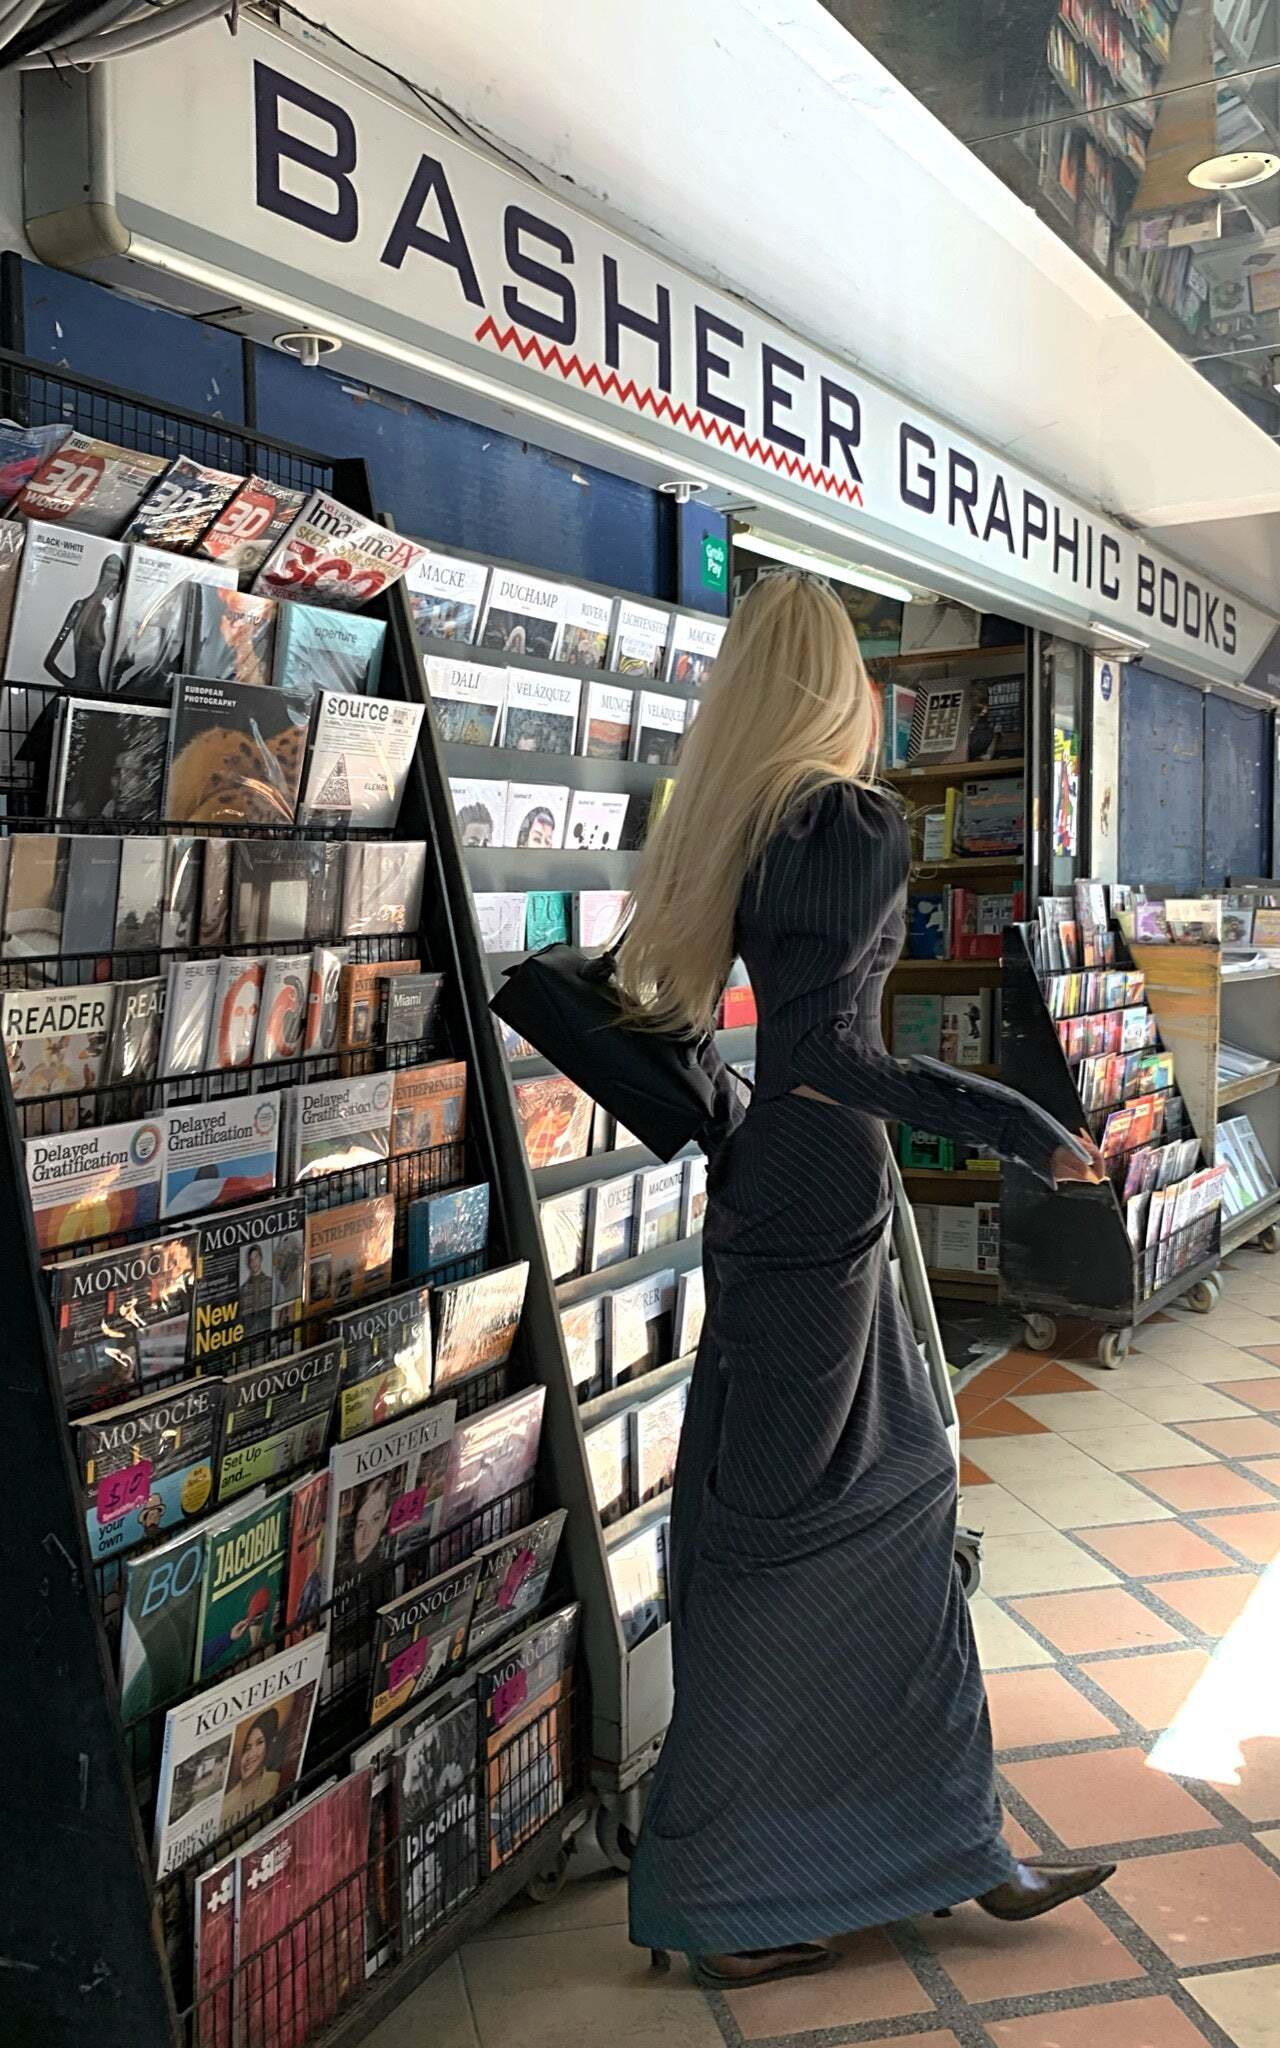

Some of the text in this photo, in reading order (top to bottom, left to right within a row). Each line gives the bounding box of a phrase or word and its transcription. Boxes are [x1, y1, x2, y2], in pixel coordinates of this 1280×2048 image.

[253, 59, 1236, 655] BASHEER GRAPHIC BOOKS
[27, 458, 96, 497] 3D
[24, 490, 75, 513] WORLD
[213, 500, 270, 538] 3D
[306, 499, 424, 569] ImaneFX
[706, 543, 724, 562] Grab
[418, 563, 466, 588] MACKE
[707, 557, 722, 579] Pay
[500, 581, 559, 609] DUCHAMP
[185, 686, 224, 697] EUROPEAN
[450, 669, 482, 690] DALÍ
[184, 695, 237, 708] PHOTOGRAPHY
[327, 696, 389, 722] source
[393, 991, 422, 1008] Miami
[6, 1001, 106, 1036] READER
[303, 1089, 351, 1111] Delayed
[168, 1111, 226, 1136] Delayed
[168, 1123, 253, 1151] Gratification
[33, 1137, 98, 1165] Delayed
[32, 1150, 129, 1182] Gratification
[204, 1208, 298, 1252] MONOCLE
[196, 1301, 239, 1331] New
[196, 1323, 245, 1354] Neue
[237, 1351, 334, 1408] MONOCLE
[96, 1390, 211, 1454] MONOCLE
[223, 1449, 262, 1472] Set Up
[355, 1418, 442, 1475] KONFEKT
[98, 1517, 126, 1540] your
[98, 1533, 124, 1552] own
[213, 1511, 282, 1588] JACOBIN
[388, 1572, 474, 1637] MONOCLE
[195, 1655, 309, 1738] KONFEKT
